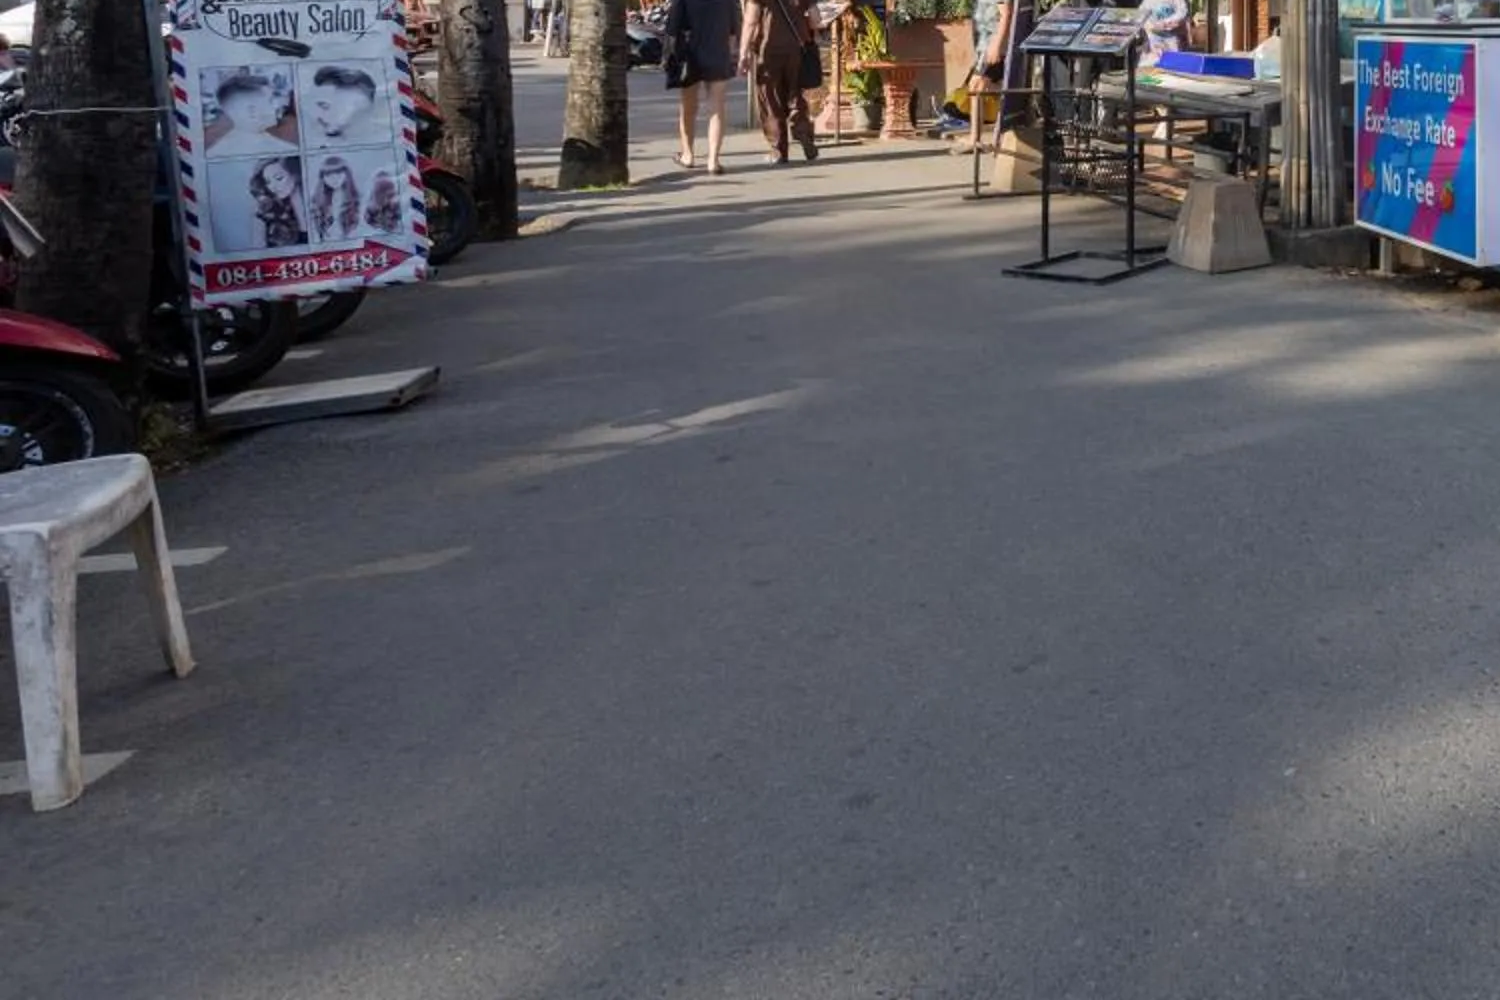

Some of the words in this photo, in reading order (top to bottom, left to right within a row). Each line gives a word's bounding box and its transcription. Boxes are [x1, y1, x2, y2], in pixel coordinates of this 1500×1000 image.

[228, 7, 299, 39] Beauty
[307, 3, 365, 33] Salon
[1359, 60, 1379, 86] The
[1383, 61, 1410, 89] Best
[1413, 63, 1464, 102] Foreign
[1365, 106, 1420, 146] Exchange
[1426, 115, 1456, 148] Rate
[1382, 161, 1401, 196] No
[1407, 168, 1434, 206] Fee
[217, 249, 389, 287] 084-430-6484
